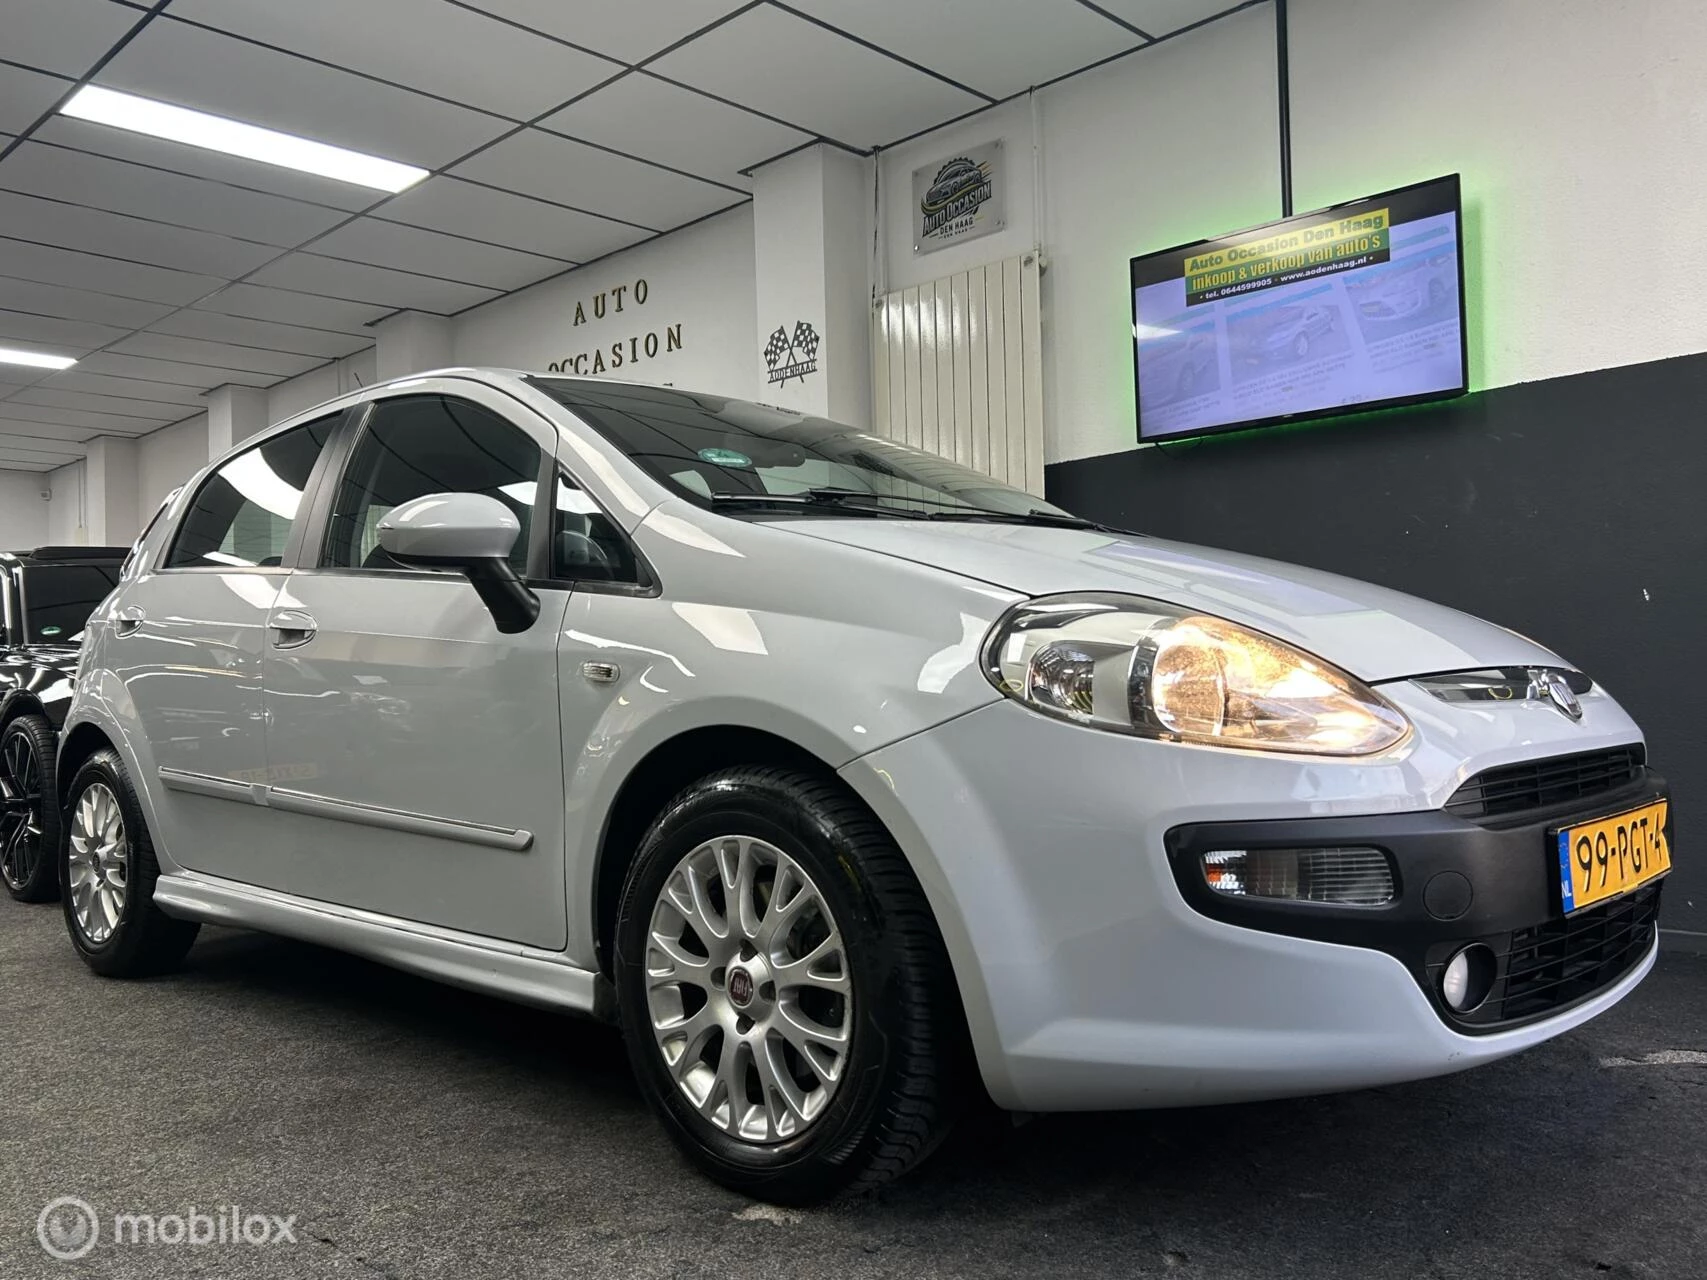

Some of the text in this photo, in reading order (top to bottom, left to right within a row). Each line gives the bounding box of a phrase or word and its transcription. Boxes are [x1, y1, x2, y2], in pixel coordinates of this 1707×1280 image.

[923, 182, 991, 237] AUTO OCCASION
[940, 223, 953, 235] DEN
[954, 217, 973, 230] HAAG
[1190, 215, 1383, 272] Auto Occasion Den Haag
[1239, 267, 1247, 280] &
[1250, 253, 1305, 277] verkoop
[1308, 246, 1332, 263] van
[1336, 234, 1381, 257] auto's
[1206, 256, 1367, 299] tel. 0644599905 www.aodenhaag.nl
[573, 279, 648, 326] AUTO
[1561, 880, 1572, 899] NL
